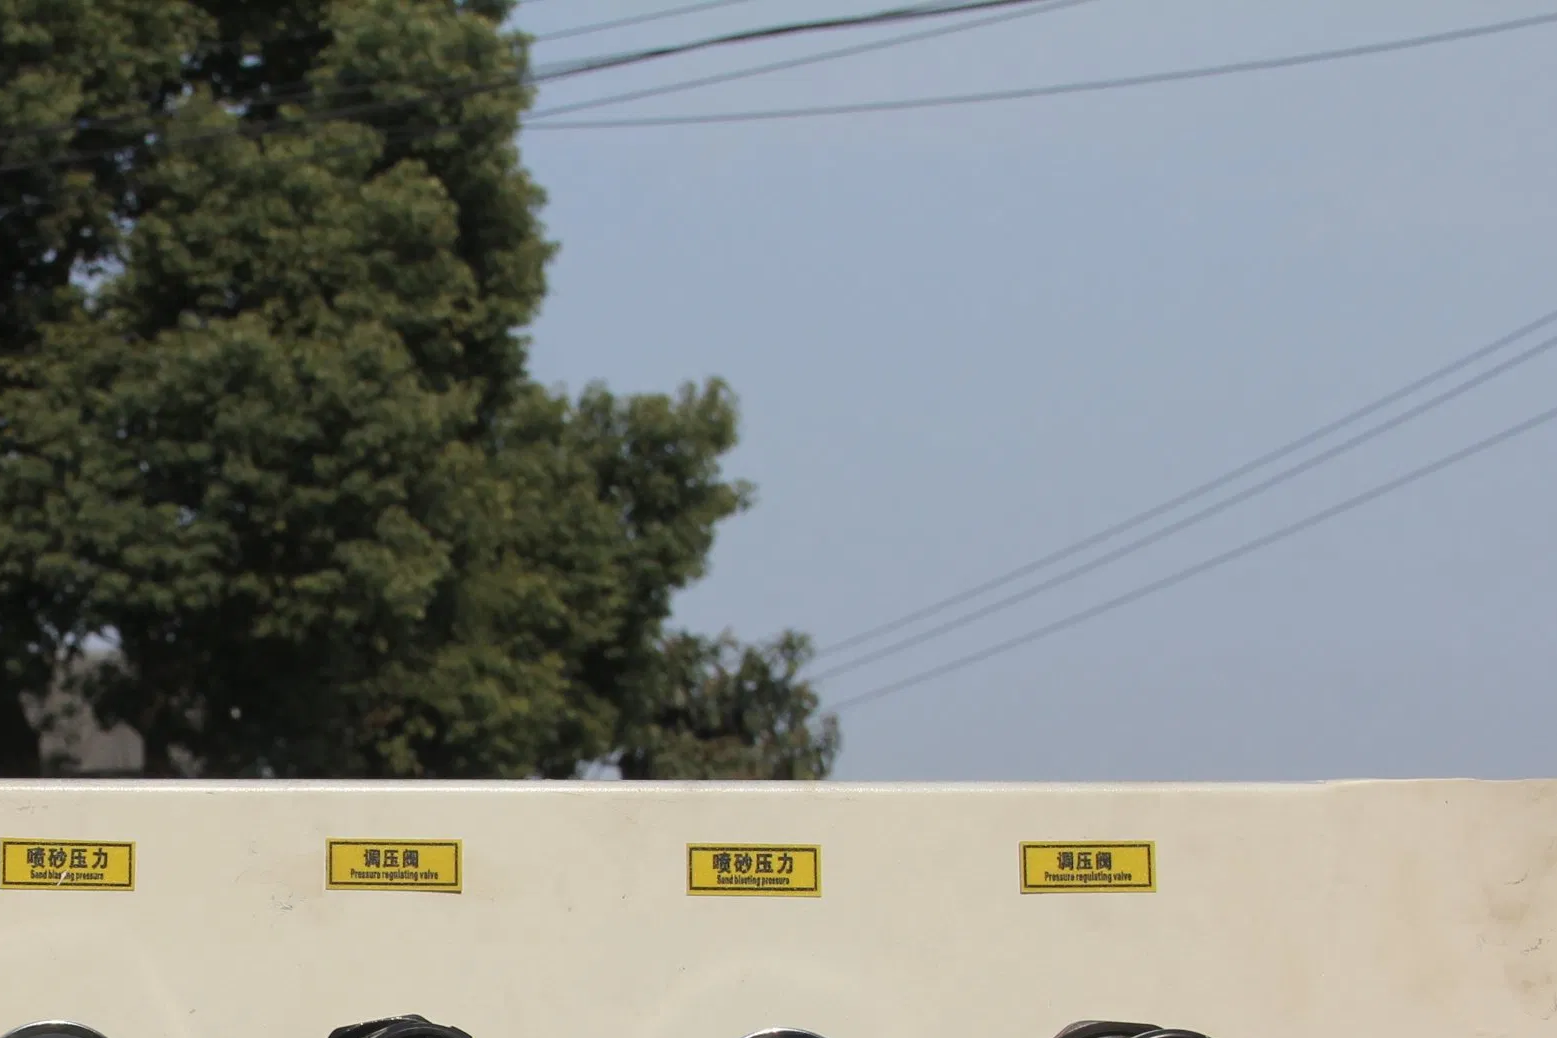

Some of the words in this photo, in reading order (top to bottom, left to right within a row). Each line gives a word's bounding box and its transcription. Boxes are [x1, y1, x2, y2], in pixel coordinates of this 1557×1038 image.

[27, 847, 108, 869] 喷砂压力
[364, 849, 419, 868] 调压阀
[713, 852, 793, 873] 喷砂压力
[1057, 852, 1112, 870] 调压阀
[351, 869, 380, 879] Pressure
[382, 870, 418, 881] regulating
[420, 870, 438, 879] valve
[1045, 872, 1074, 881] Pressure
[1076, 872, 1112, 883] regulating
[1113, 872, 1132, 881] valve
